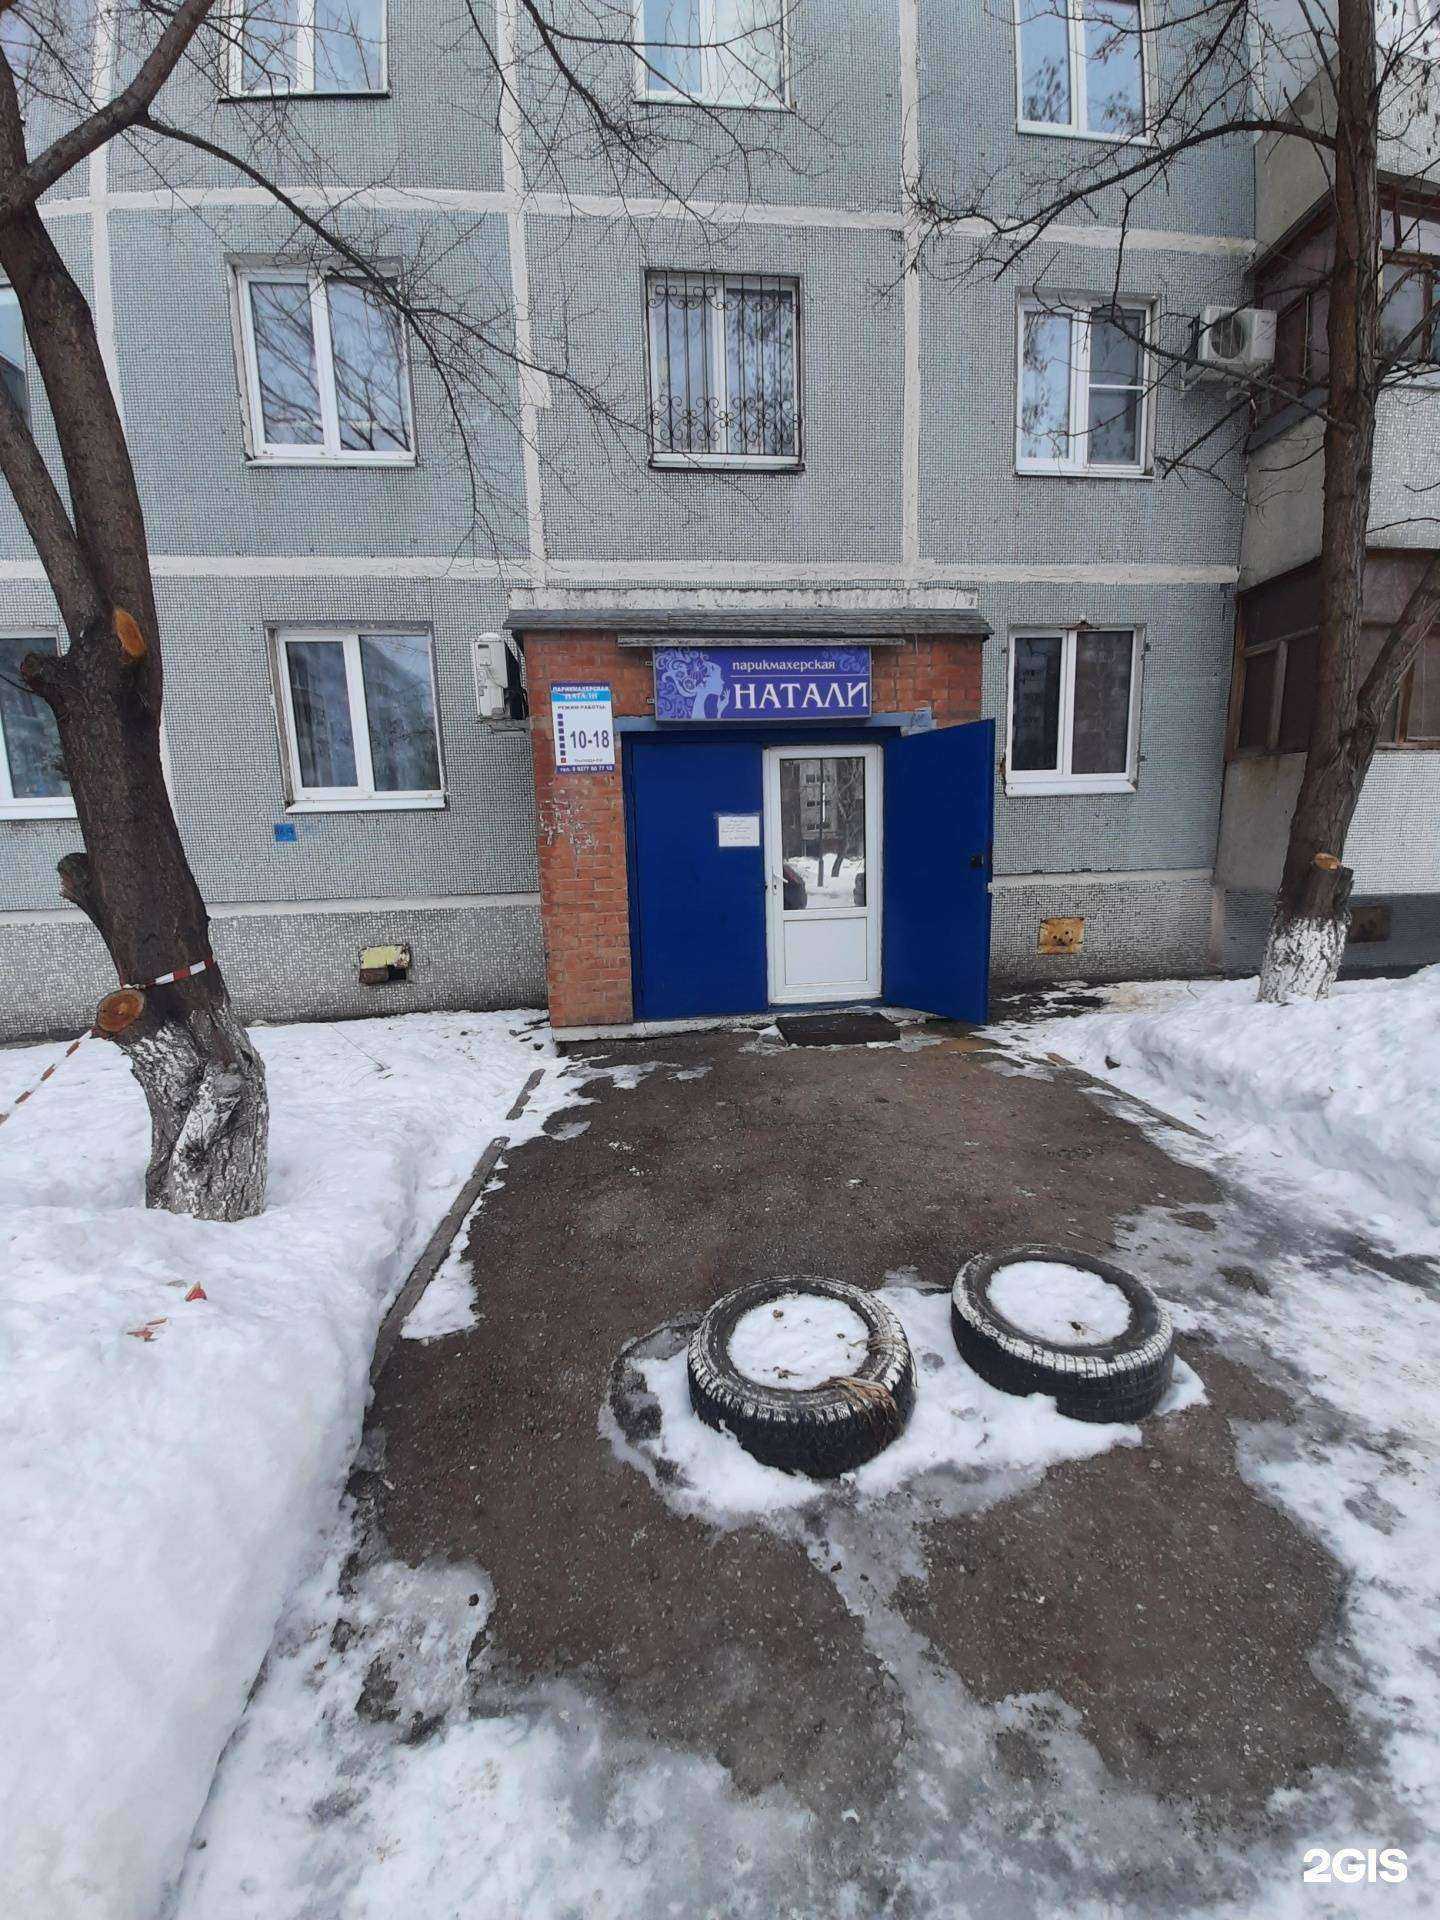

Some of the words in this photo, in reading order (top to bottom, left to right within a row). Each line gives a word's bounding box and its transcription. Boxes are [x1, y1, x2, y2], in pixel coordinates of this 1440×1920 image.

[732, 659, 836, 672] парикмахерская
[734, 682, 868, 709] НАТАЛИ
[570, 730, 610, 748] 10-18
